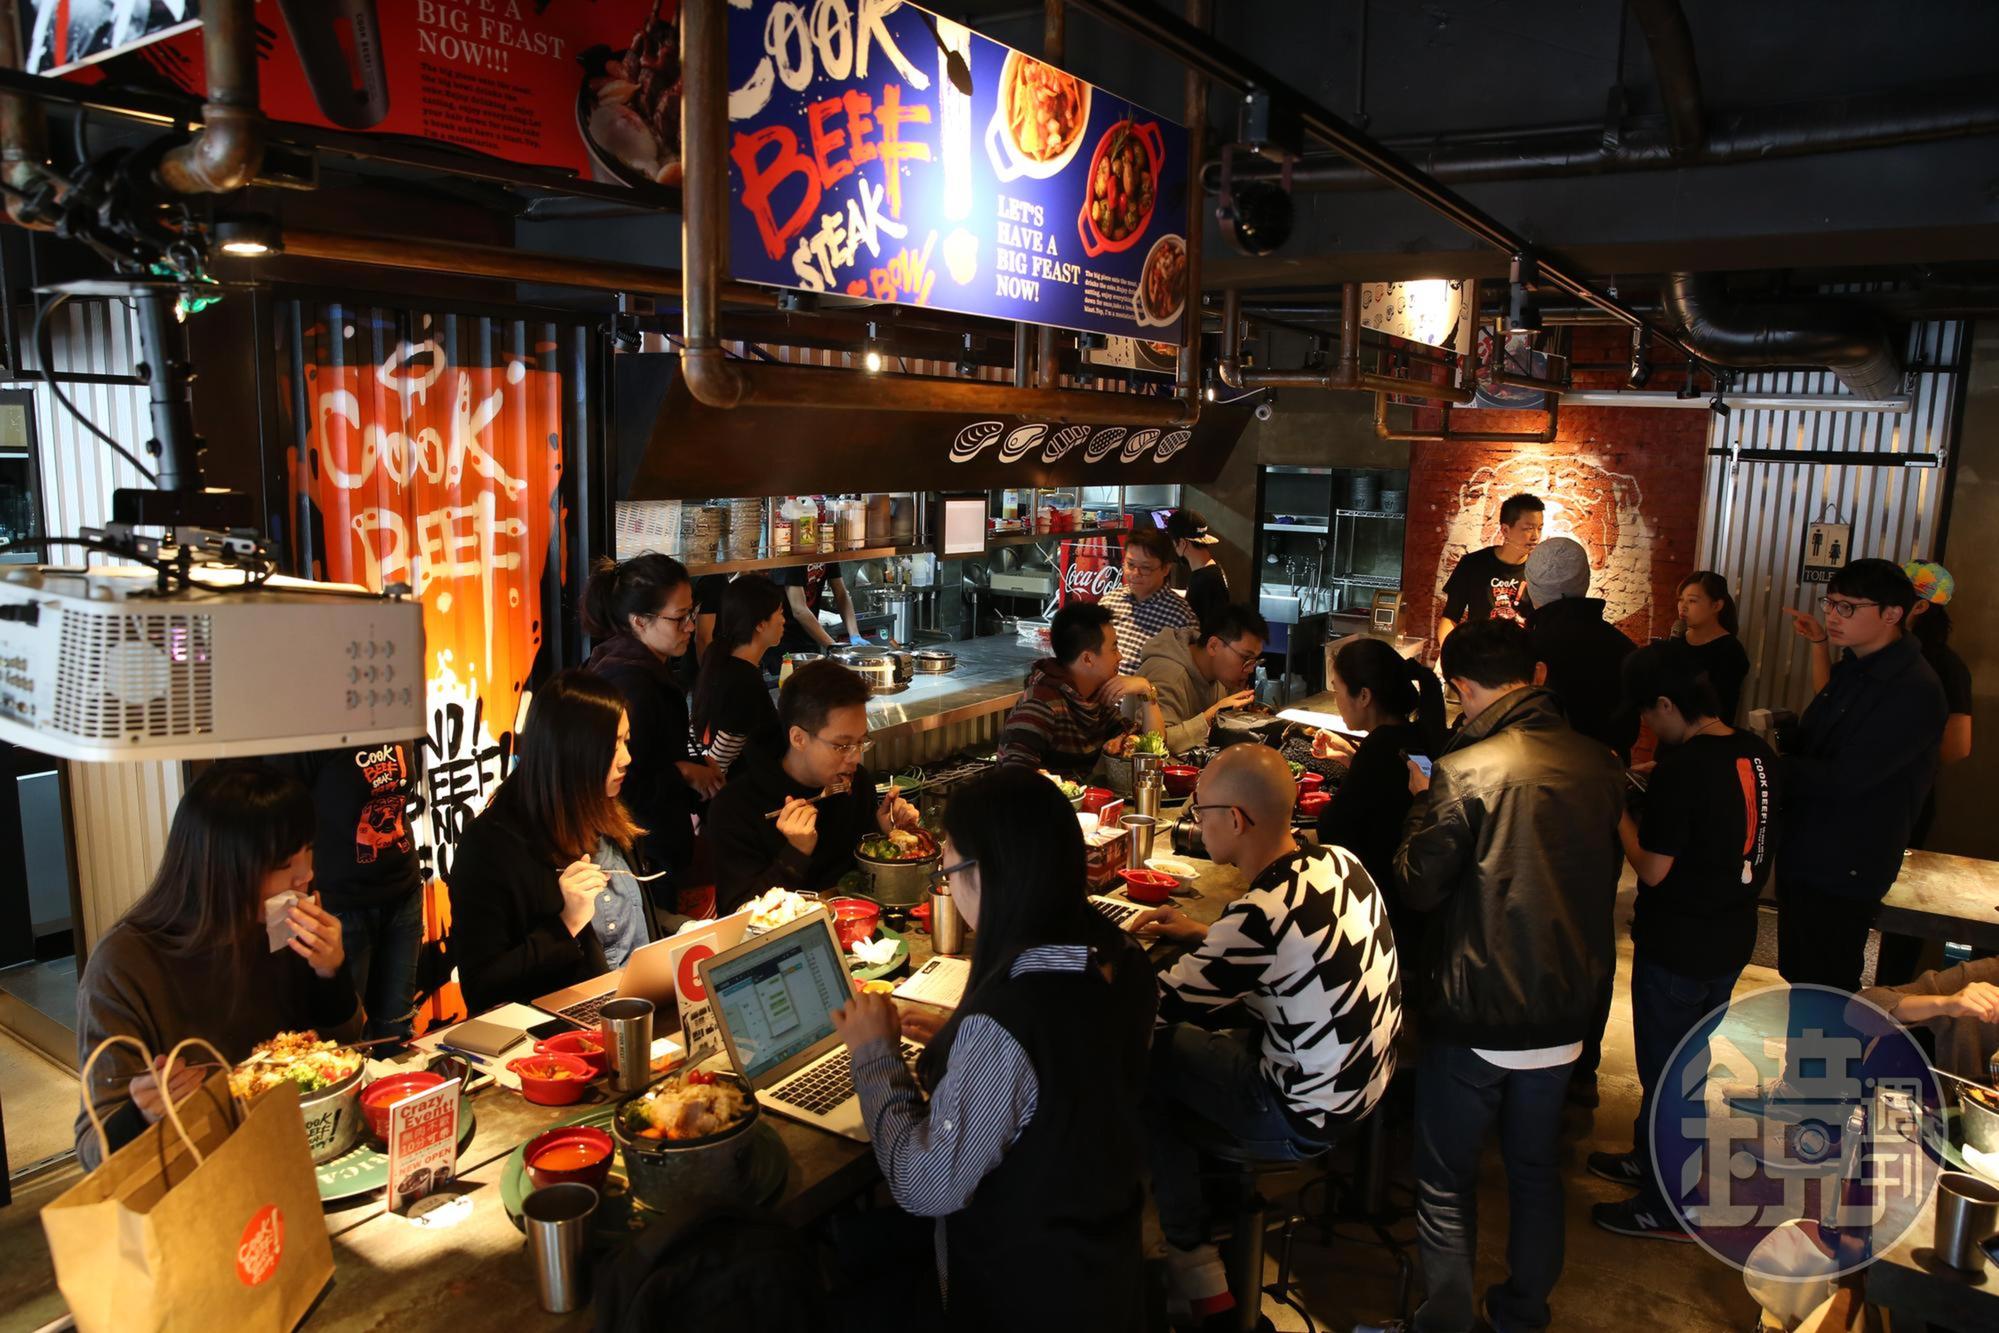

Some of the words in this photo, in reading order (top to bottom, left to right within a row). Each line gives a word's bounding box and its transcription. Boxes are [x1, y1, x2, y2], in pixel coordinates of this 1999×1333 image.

[417, 0, 469, 34] BIG
[480, 16, 565, 59] FEAST
[417, 28, 509, 72] NOW!!!
[730, 84, 932, 260] BEEF
[998, 194, 1044, 227] LET'S
[792, 178, 908, 292] STEAK
[998, 221, 1043, 252] HAVE
[1046, 235, 1058, 256] A
[997, 248, 1027, 276] BIG
[1032, 256, 1080, 285] FEAST
[996, 275, 1040, 302] NOW!
[1806, 570, 1837, 582] TOILE
[1753, 757, 1768, 787] COOK
[306, 1112, 333, 1130] OOK
[401, 1093, 445, 1119] Crazy
[405, 1099, 455, 1129] Event!
[424, 1147, 451, 1164] OPEN
